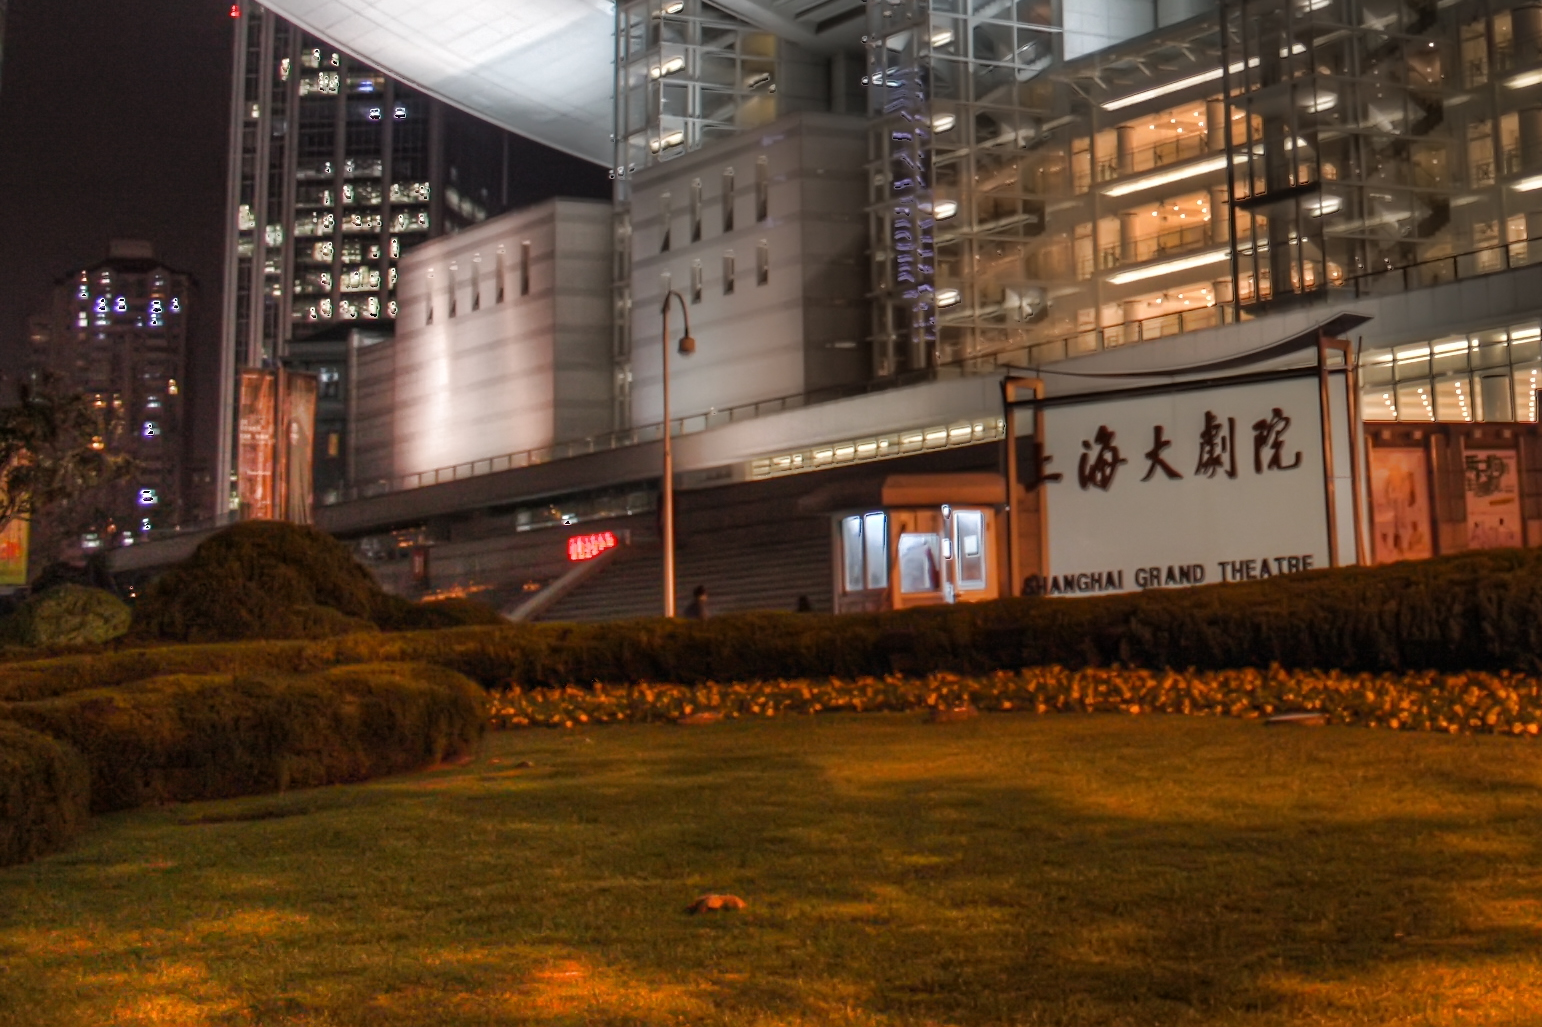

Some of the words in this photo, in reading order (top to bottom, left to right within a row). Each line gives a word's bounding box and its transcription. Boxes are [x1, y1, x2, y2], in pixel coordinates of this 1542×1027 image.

[1022, 568, 1125, 597] SHANGHAI
[1135, 563, 1205, 589] GRAND
[1218, 553, 1314, 583] THEATRE
